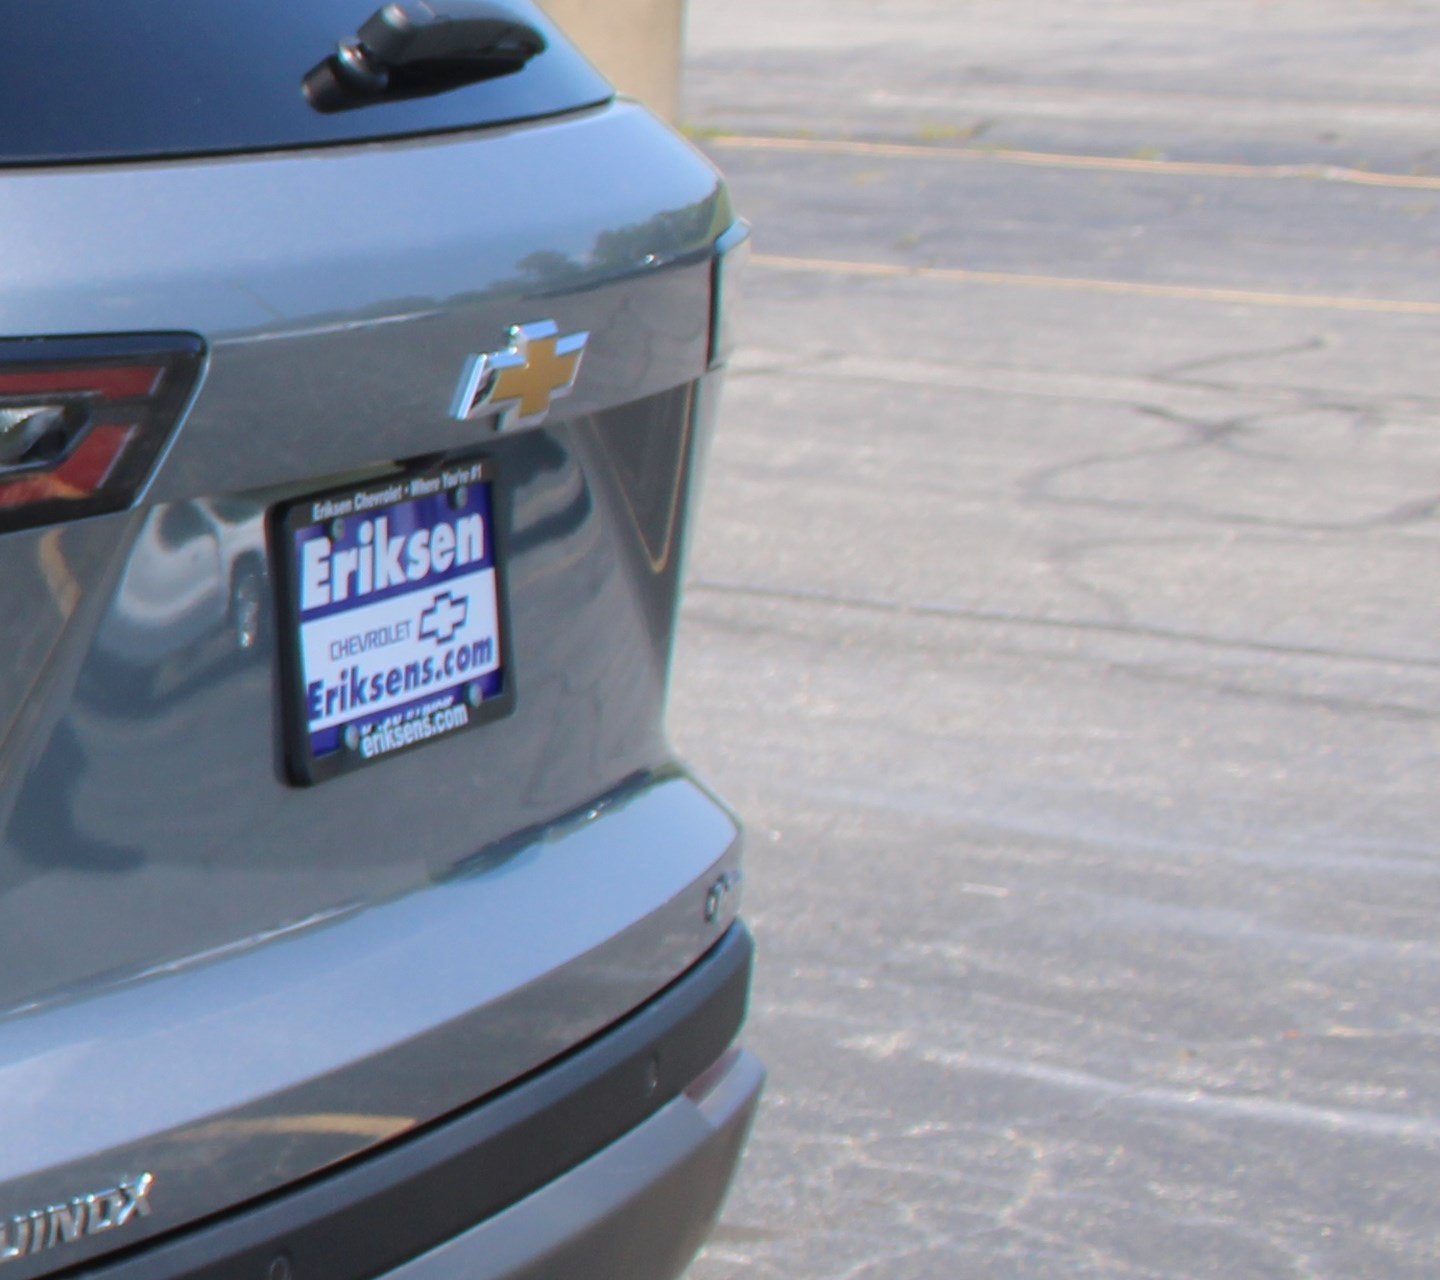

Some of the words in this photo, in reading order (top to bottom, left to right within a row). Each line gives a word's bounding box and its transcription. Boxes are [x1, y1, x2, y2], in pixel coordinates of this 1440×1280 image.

[301, 512, 485, 612] Eriksen
[330, 620, 412, 662] CHEVROLET
[306, 635, 493, 721] Eriksens.com
[360, 703, 468, 759] eriksens.com
